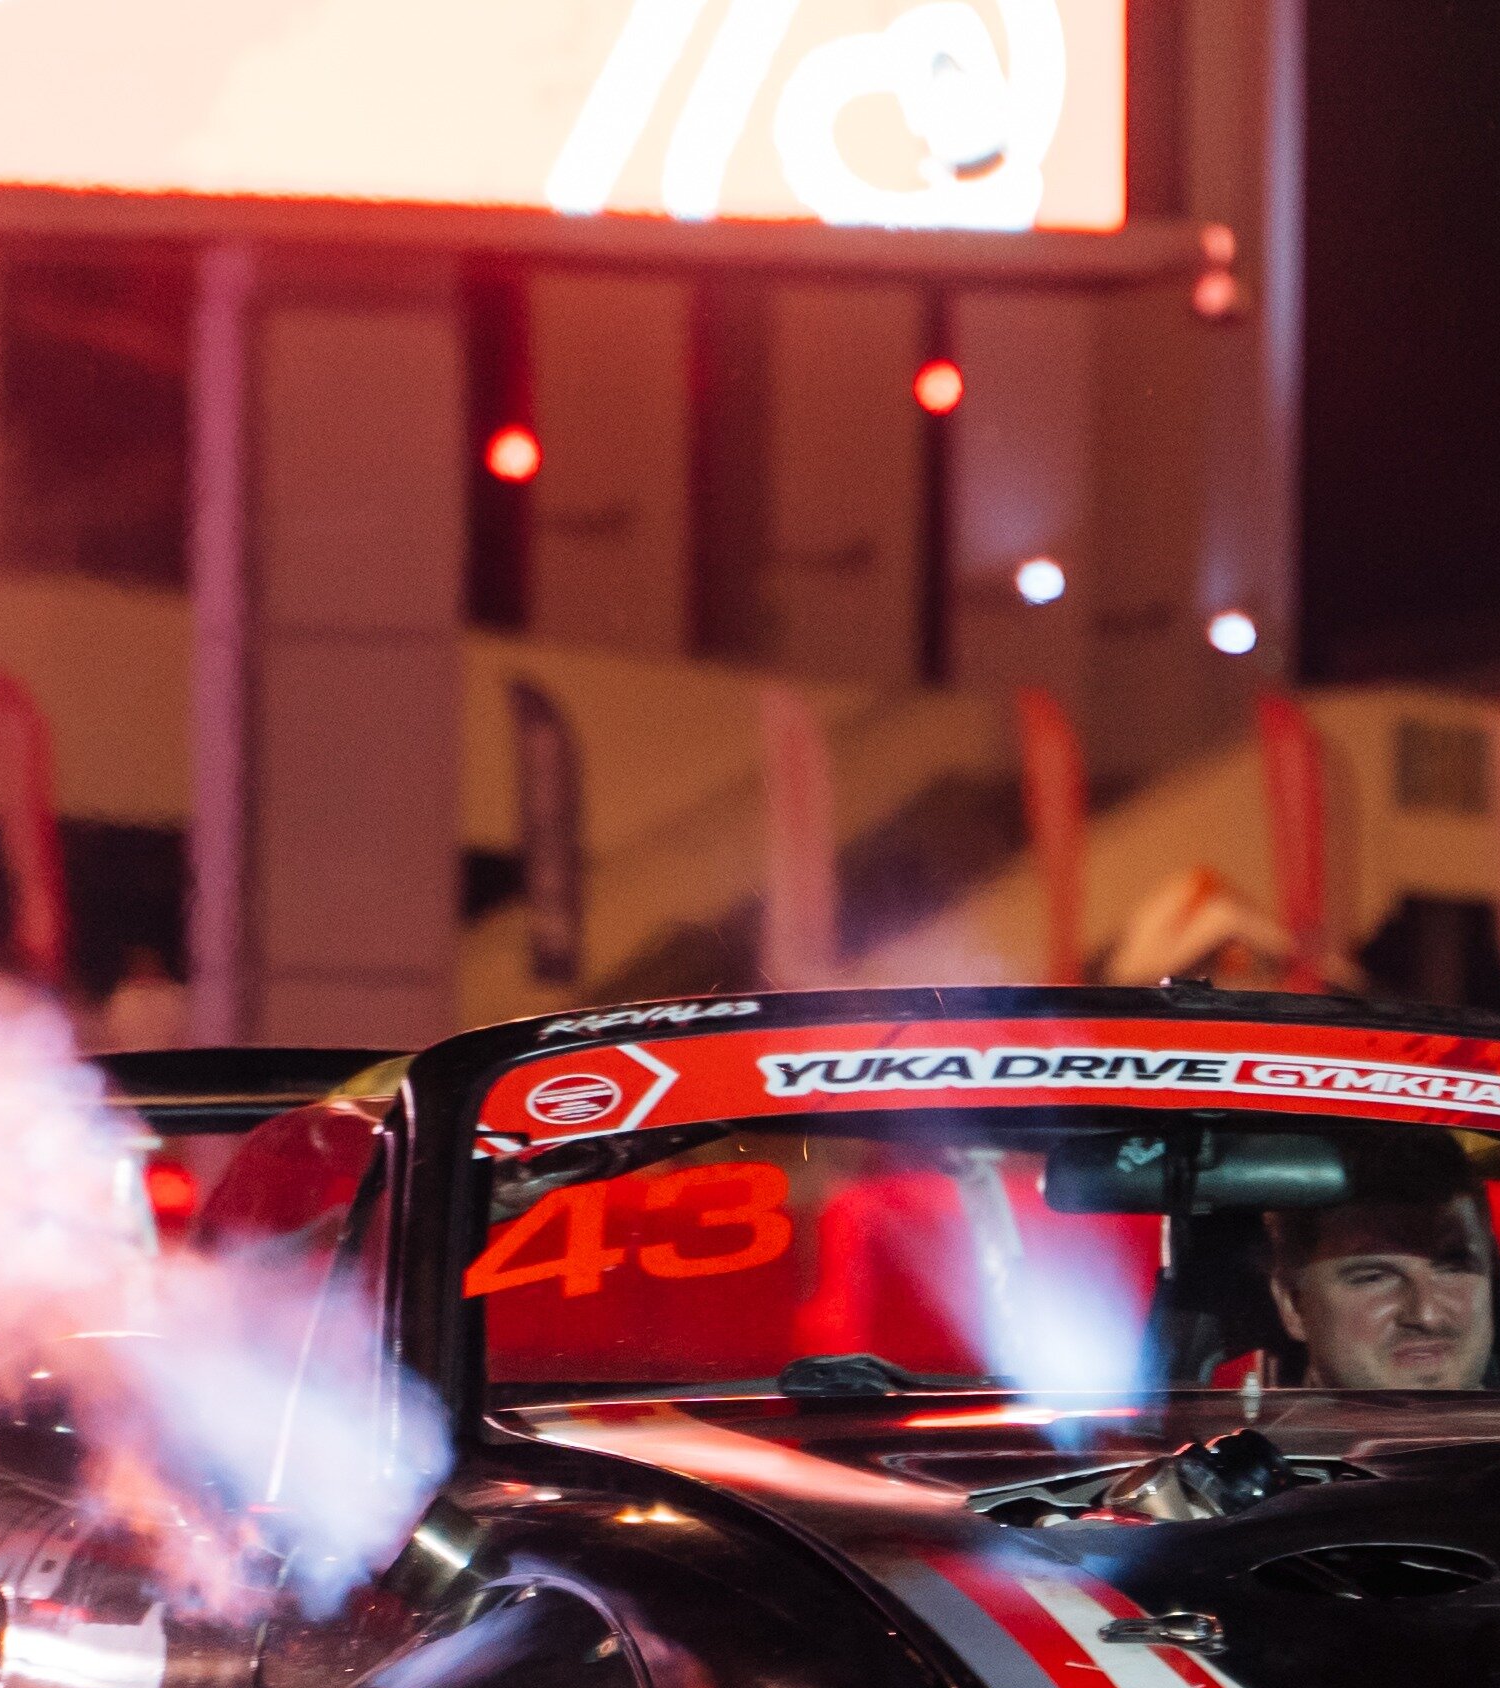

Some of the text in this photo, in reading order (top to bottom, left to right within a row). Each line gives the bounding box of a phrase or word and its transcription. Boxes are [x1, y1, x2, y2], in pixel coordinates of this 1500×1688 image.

[775, 1056, 972, 1087] YUKA
[992, 1055, 1228, 1082] DRIVE
[464, 1162, 792, 1297] 43
